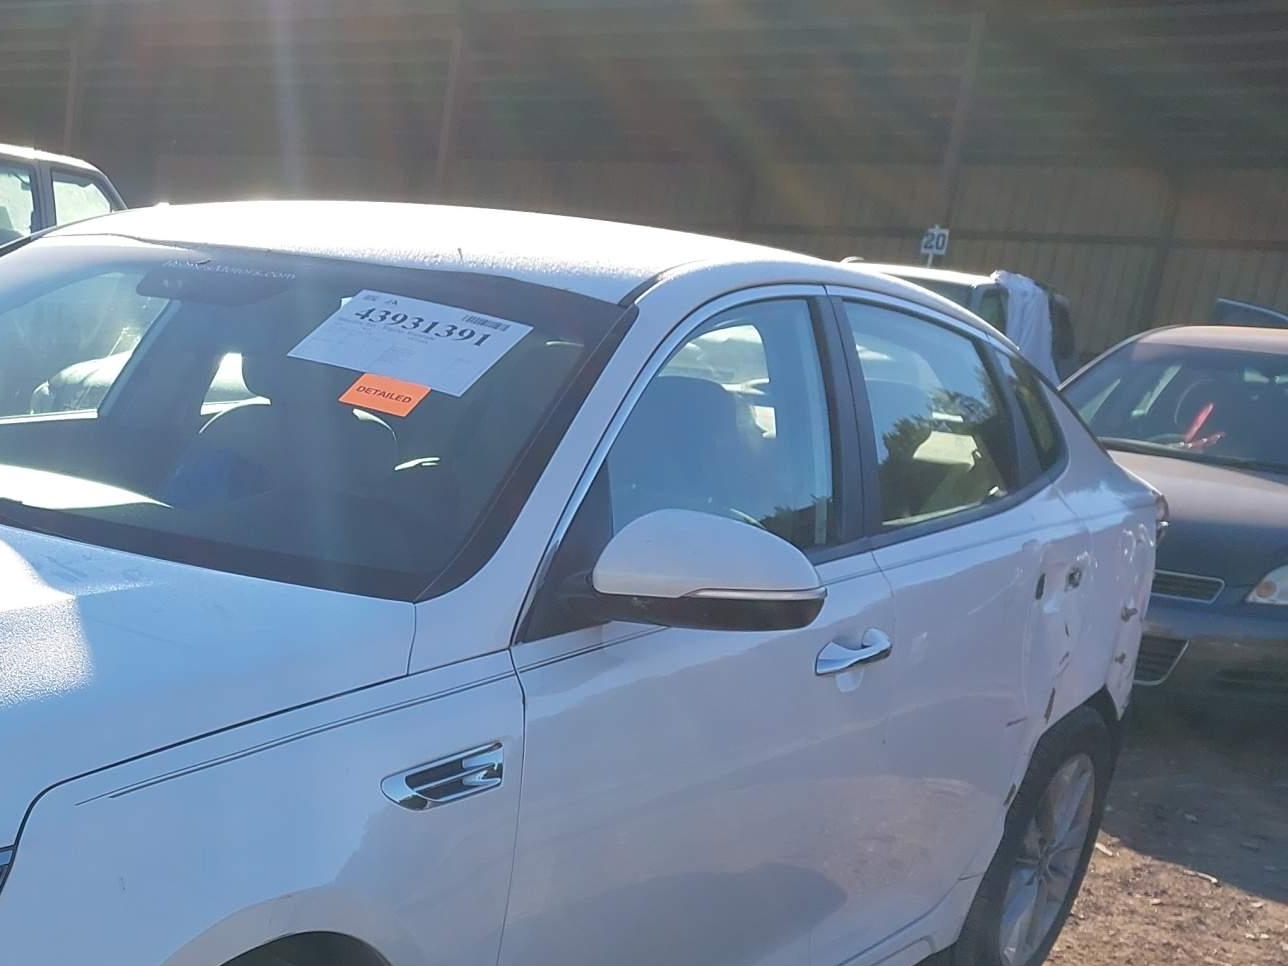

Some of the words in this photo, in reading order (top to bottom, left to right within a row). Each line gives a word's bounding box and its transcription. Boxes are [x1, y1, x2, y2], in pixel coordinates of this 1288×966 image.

[923, 232, 946, 251] 20
[355, 307, 491, 347] 43931391
[355, 385, 412, 404] DETAILED
